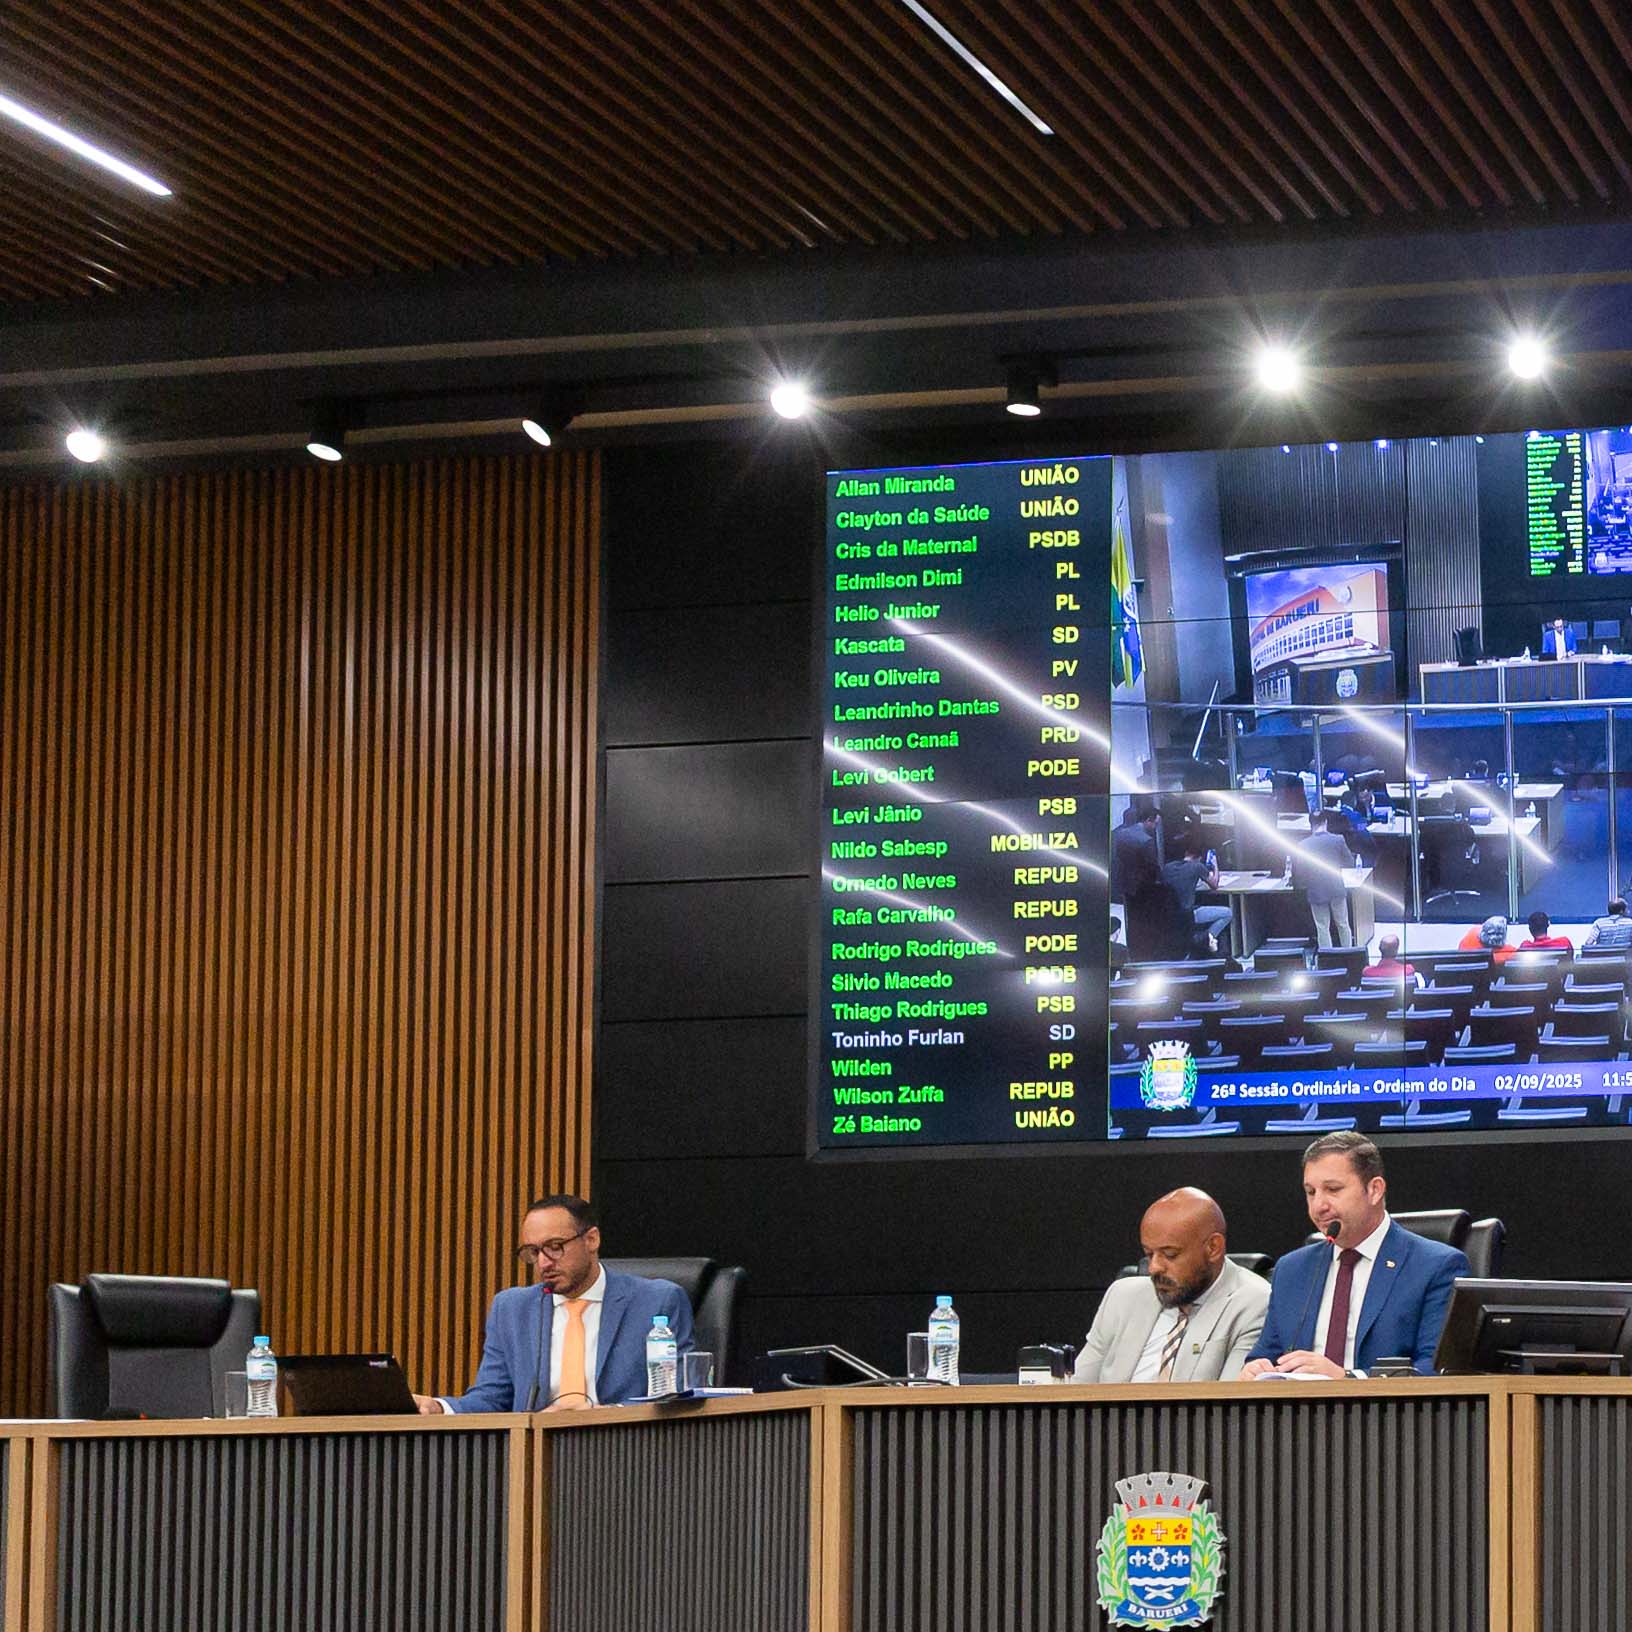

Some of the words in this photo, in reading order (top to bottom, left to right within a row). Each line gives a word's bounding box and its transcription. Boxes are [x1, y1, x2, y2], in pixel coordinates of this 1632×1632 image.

[1021, 465, 1079, 486] UNIÃO
[836, 479, 880, 497] Allan
[885, 477, 955, 494] Miranda
[1021, 497, 1079, 517] UNIÃO
[836, 511, 902, 530] Clayton
[909, 508, 929, 525] da
[934, 504, 989, 524] Saúde
[836, 541, 870, 559] Cris
[876, 540, 898, 557] da
[903, 537, 977, 555] Maternal
[1030, 531, 1080, 548] PSDB
[836, 573, 917, 591] Edmilson
[923, 569, 962, 587] Dimi
[1056, 563, 1080, 579] PL
[1056, 595, 1080, 611] PL
[835, 605, 879, 622] Helio
[883, 603, 940, 619] Junior
[1053, 627, 1078, 643] SD
[835, 636, 905, 654] Kascata
[1053, 660, 1077, 677] PV
[835, 672, 869, 688] Keu
[874, 668, 940, 686] Oliveira
[834, 704, 934, 721] Leandrinho
[939, 700, 999, 716] Dantas
[1042, 694, 1079, 709] PSD
[834, 734, 902, 752] Leandro
[907, 731, 958, 748] Canaã
[1042, 727, 1079, 743] PRD
[833, 769, 868, 786] Levi
[874, 766, 934, 783] Gobert
[1028, 759, 1080, 776] PODE
[833, 807, 869, 824] Levi
[874, 805, 922, 823] Jânio
[1039, 799, 1077, 815] PSB
[832, 842, 877, 858] Nildo
[882, 840, 948, 858] Sabesp
[991, 833, 1078, 852] MOBILIZA
[903, 873, 956, 889] Neves
[1015, 867, 1078, 884] REPUB
[833, 908, 872, 925] Rafa
[877, 906, 955, 923] Carvalho
[1015, 900, 1078, 917] REPUB
[832, 942, 901, 962] Rodrigo
[907, 940, 997, 959] Rodrigues
[1025, 935, 1077, 952] PODE
[832, 974, 879, 992] Silvio
[885, 971, 952, 989] Macedo
[832, 1003, 892, 1022] Thiago
[897, 1001, 987, 1021] Rodrigues
[1037, 996, 1075, 1013] PSB
[832, 1030, 902, 1048] Toninho
[909, 1029, 964, 1045] Furlan
[1050, 1025, 1075, 1040] SD
[832, 1060, 892, 1077] Wilden
[1049, 1053, 1073, 1069] PP
[834, 1088, 893, 1104] Wilson
[899, 1086, 944, 1103] Zuffa
[1010, 1082, 1074, 1099] REPUB
[1211, 1083, 1235, 1099] 26ª
[1240, 1083, 1288, 1098] Sessão
[1292, 1080, 1360, 1096] Ordinária
[1373, 1079, 1424, 1094] Ordem
[1429, 1077, 1447, 1092] do
[1452, 1077, 1475, 1091] Dia
[1494, 1073, 1582, 1091] 02/09/2025
[833, 1115, 856, 1133] Zé
[861, 1116, 921, 1132] Baiano
[1016, 1108, 1075, 1127] UNIÃO
[1128, 1603, 1188, 1618] BARUERI
